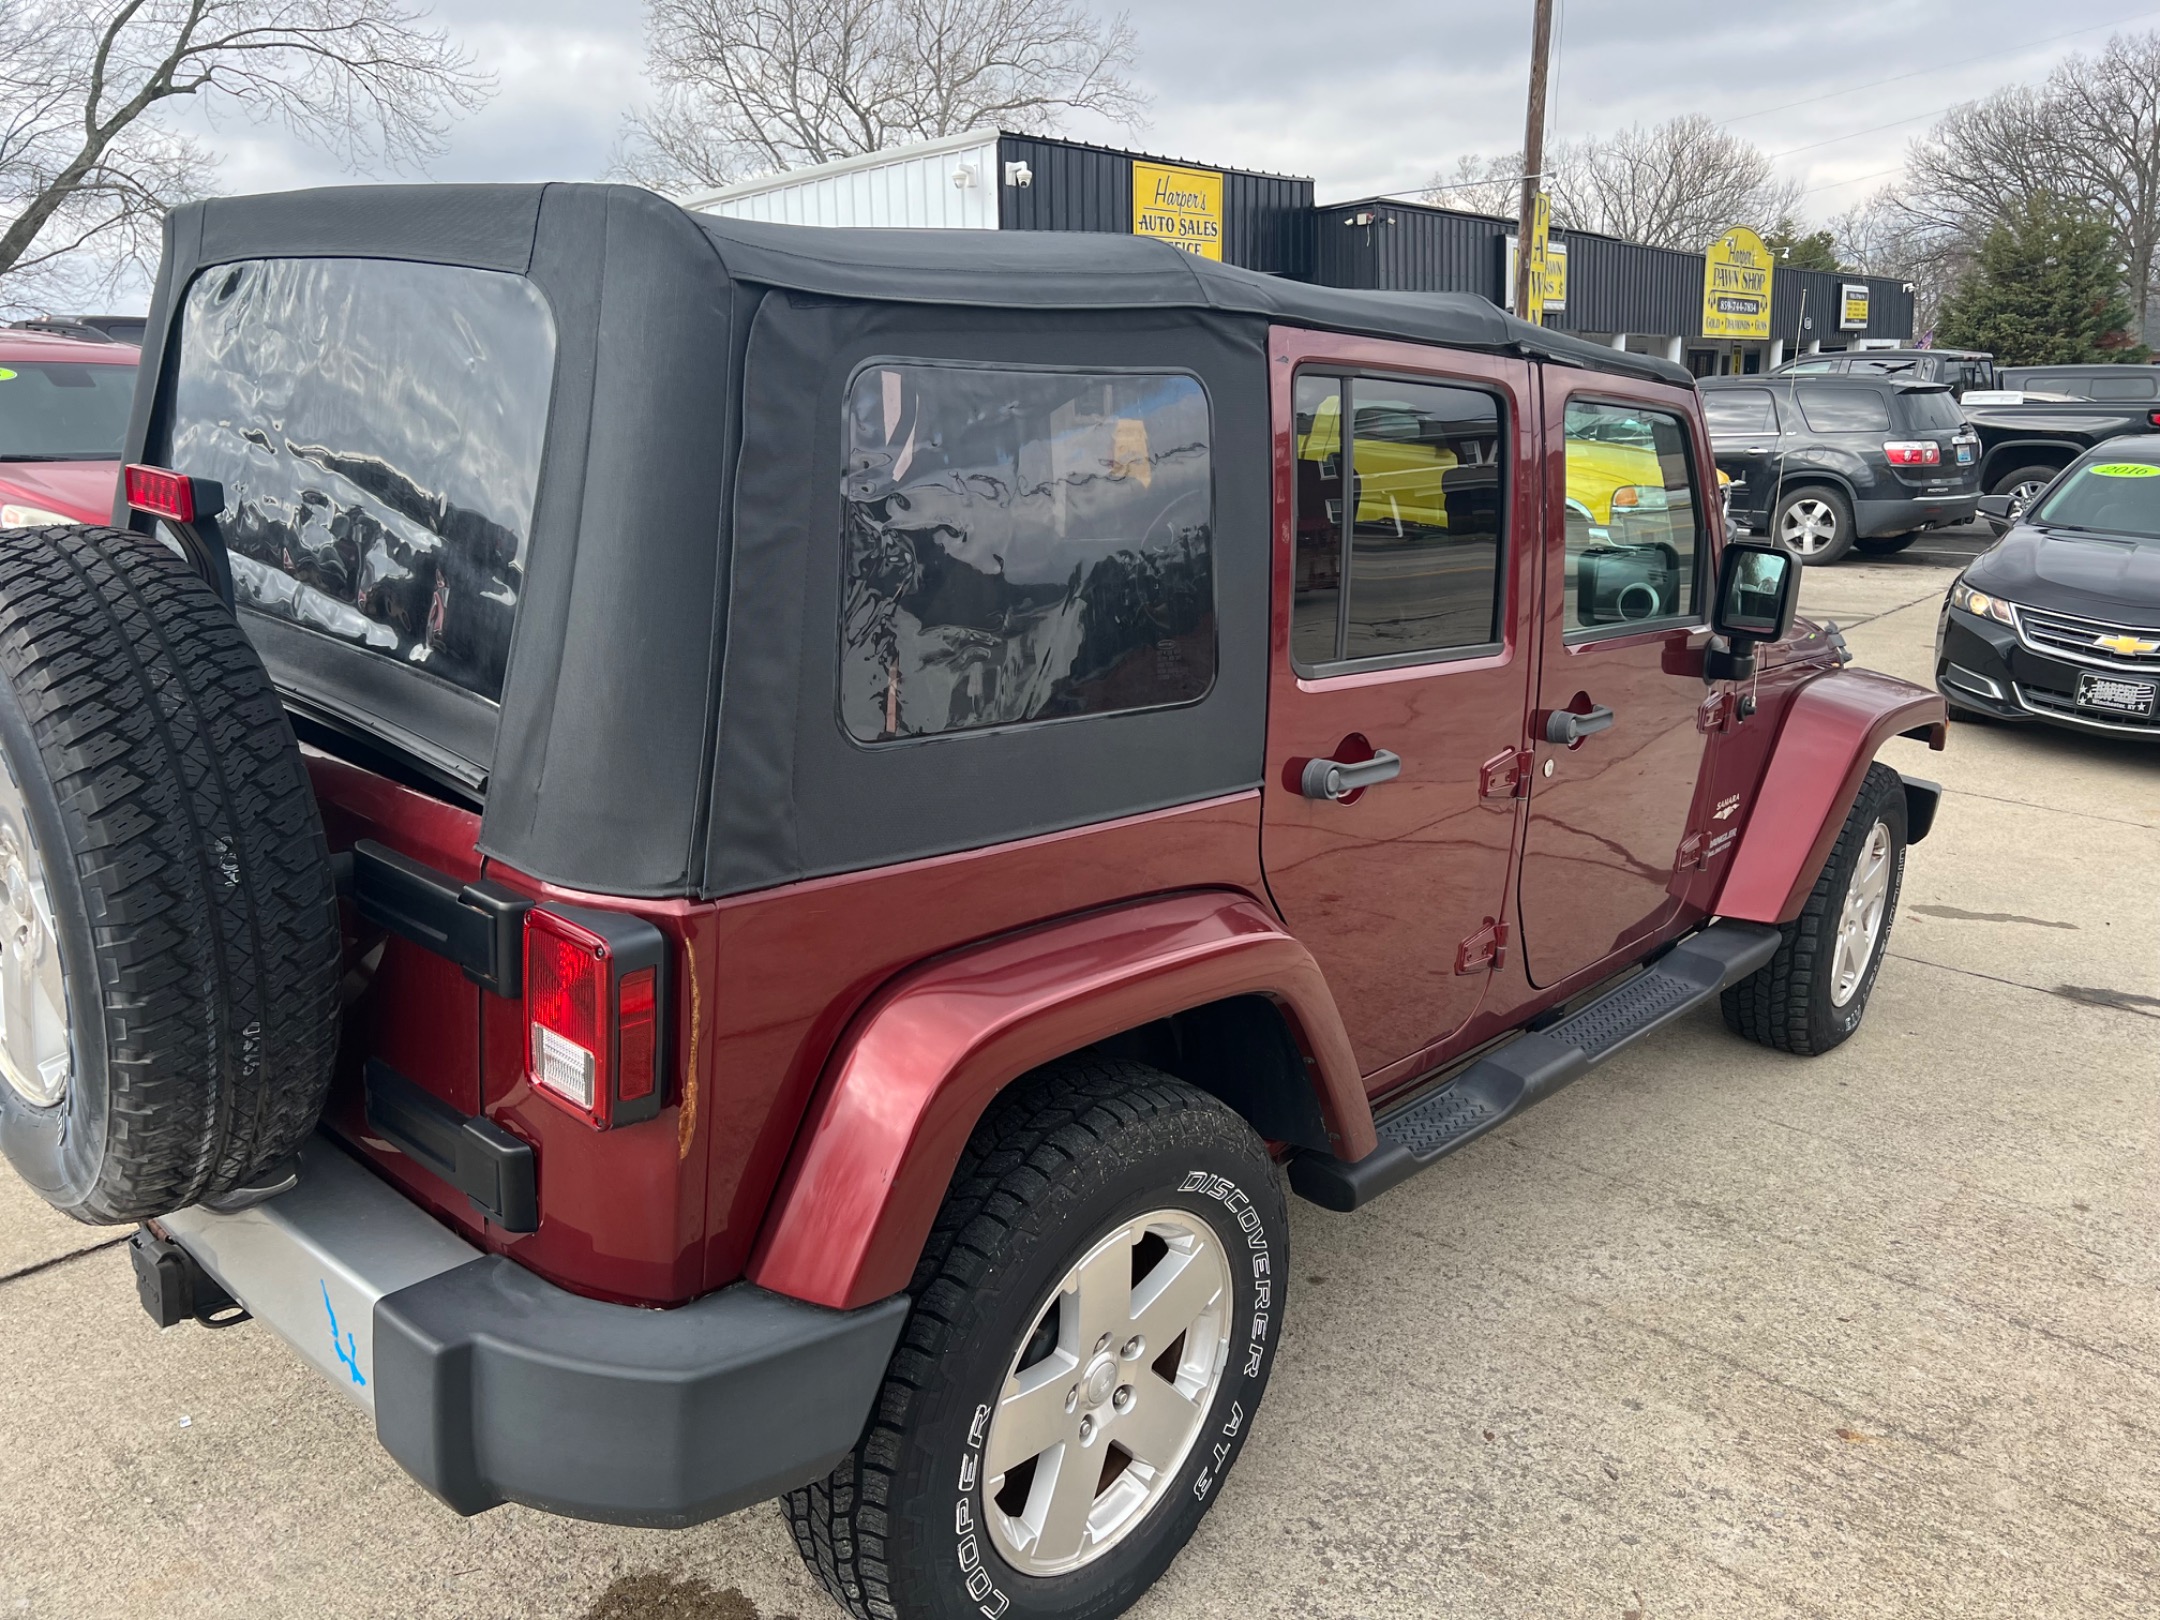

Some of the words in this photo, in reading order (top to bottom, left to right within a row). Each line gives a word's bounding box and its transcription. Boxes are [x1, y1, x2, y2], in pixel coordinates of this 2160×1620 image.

[1154, 175, 1206, 216] Harper's
[1138, 214, 1175, 233] AUTO
[1179, 218, 1217, 237] SALES
[1713, 267, 1739, 288] PAWN
[1742, 272, 1766, 291] SHOP
[2101, 466, 2148, 474] 2016
[1177, 1170, 1271, 1379] DISCOVERER
[1193, 1400, 1244, 1502] AT3
[955, 1403, 1010, 1620] COOPER
